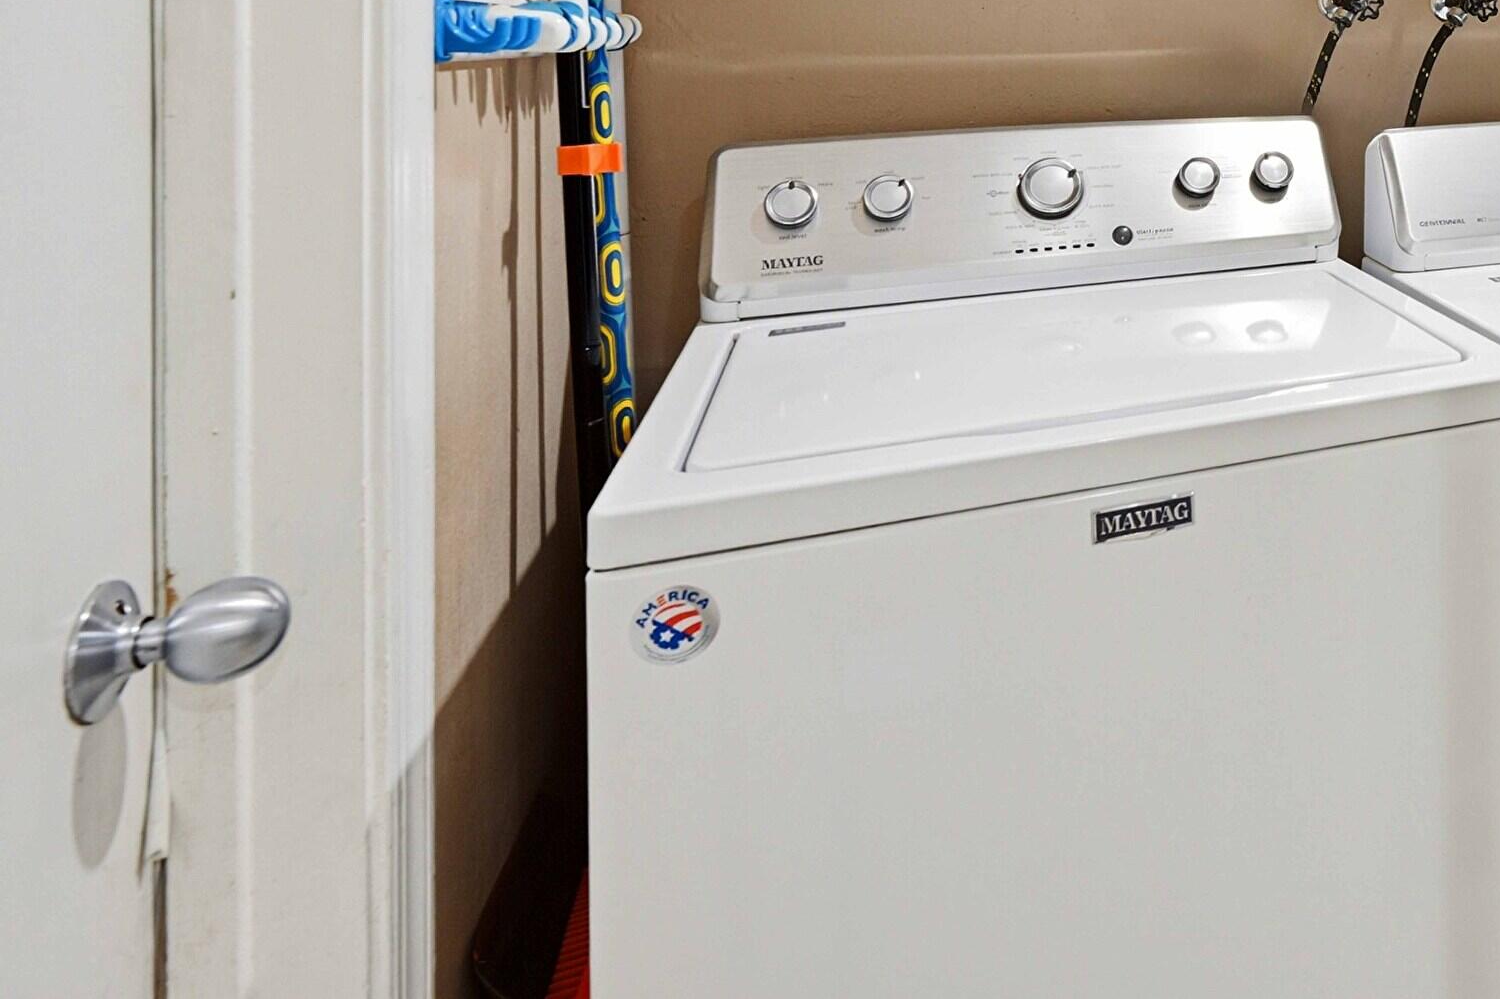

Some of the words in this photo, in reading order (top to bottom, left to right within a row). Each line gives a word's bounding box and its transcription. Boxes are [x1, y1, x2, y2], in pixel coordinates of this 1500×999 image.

[762, 255, 824, 270] MAYTAG
[1100, 502, 1189, 535] MAYTAG
[636, 589, 710, 629] AMERICA
